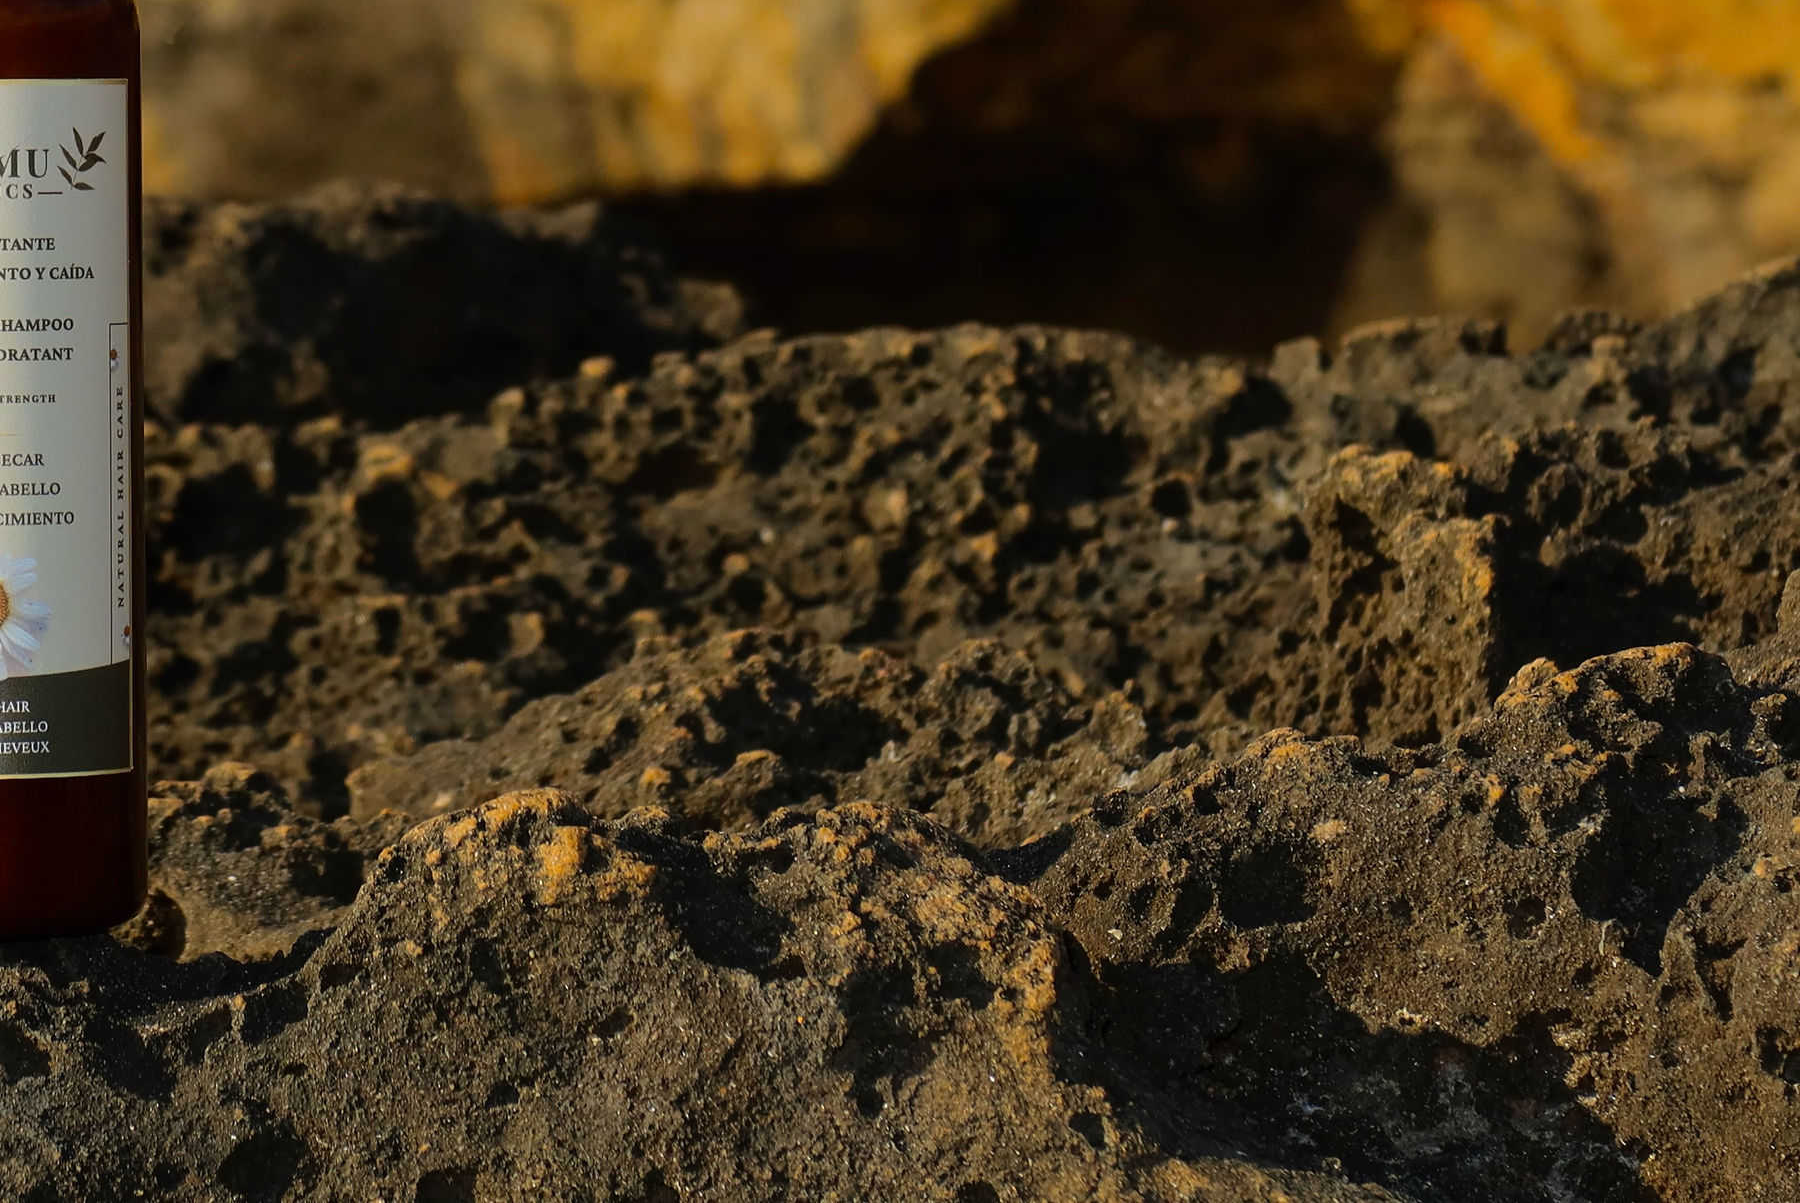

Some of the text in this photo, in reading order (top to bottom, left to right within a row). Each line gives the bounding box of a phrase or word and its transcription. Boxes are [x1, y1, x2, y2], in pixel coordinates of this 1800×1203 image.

[34, 267, 48, 280] Y
[49, 263, 95, 280] CAÍDA
[115, 386, 125, 609] NATURAL HAIR CARE
